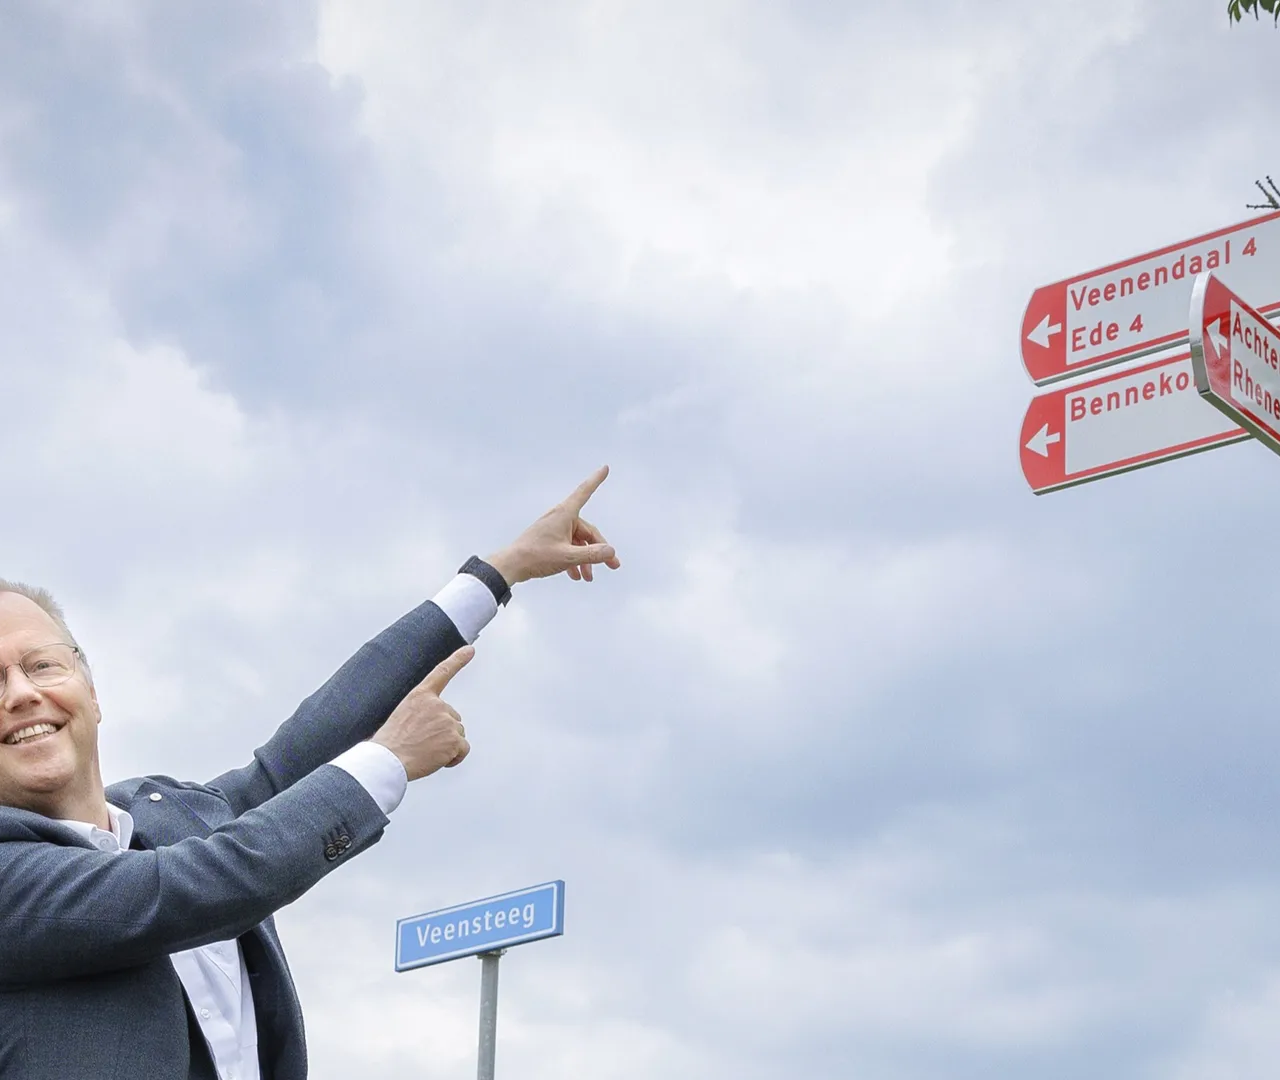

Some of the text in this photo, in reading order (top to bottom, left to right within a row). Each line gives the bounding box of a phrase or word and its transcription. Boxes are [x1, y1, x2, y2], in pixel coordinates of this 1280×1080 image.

[1070, 236, 1257, 311] Veenendaal 4
[1072, 314, 1144, 352] Ede 4
[1070, 371, 1197, 422] Benneko
[416, 902, 536, 948] Veensteeg
